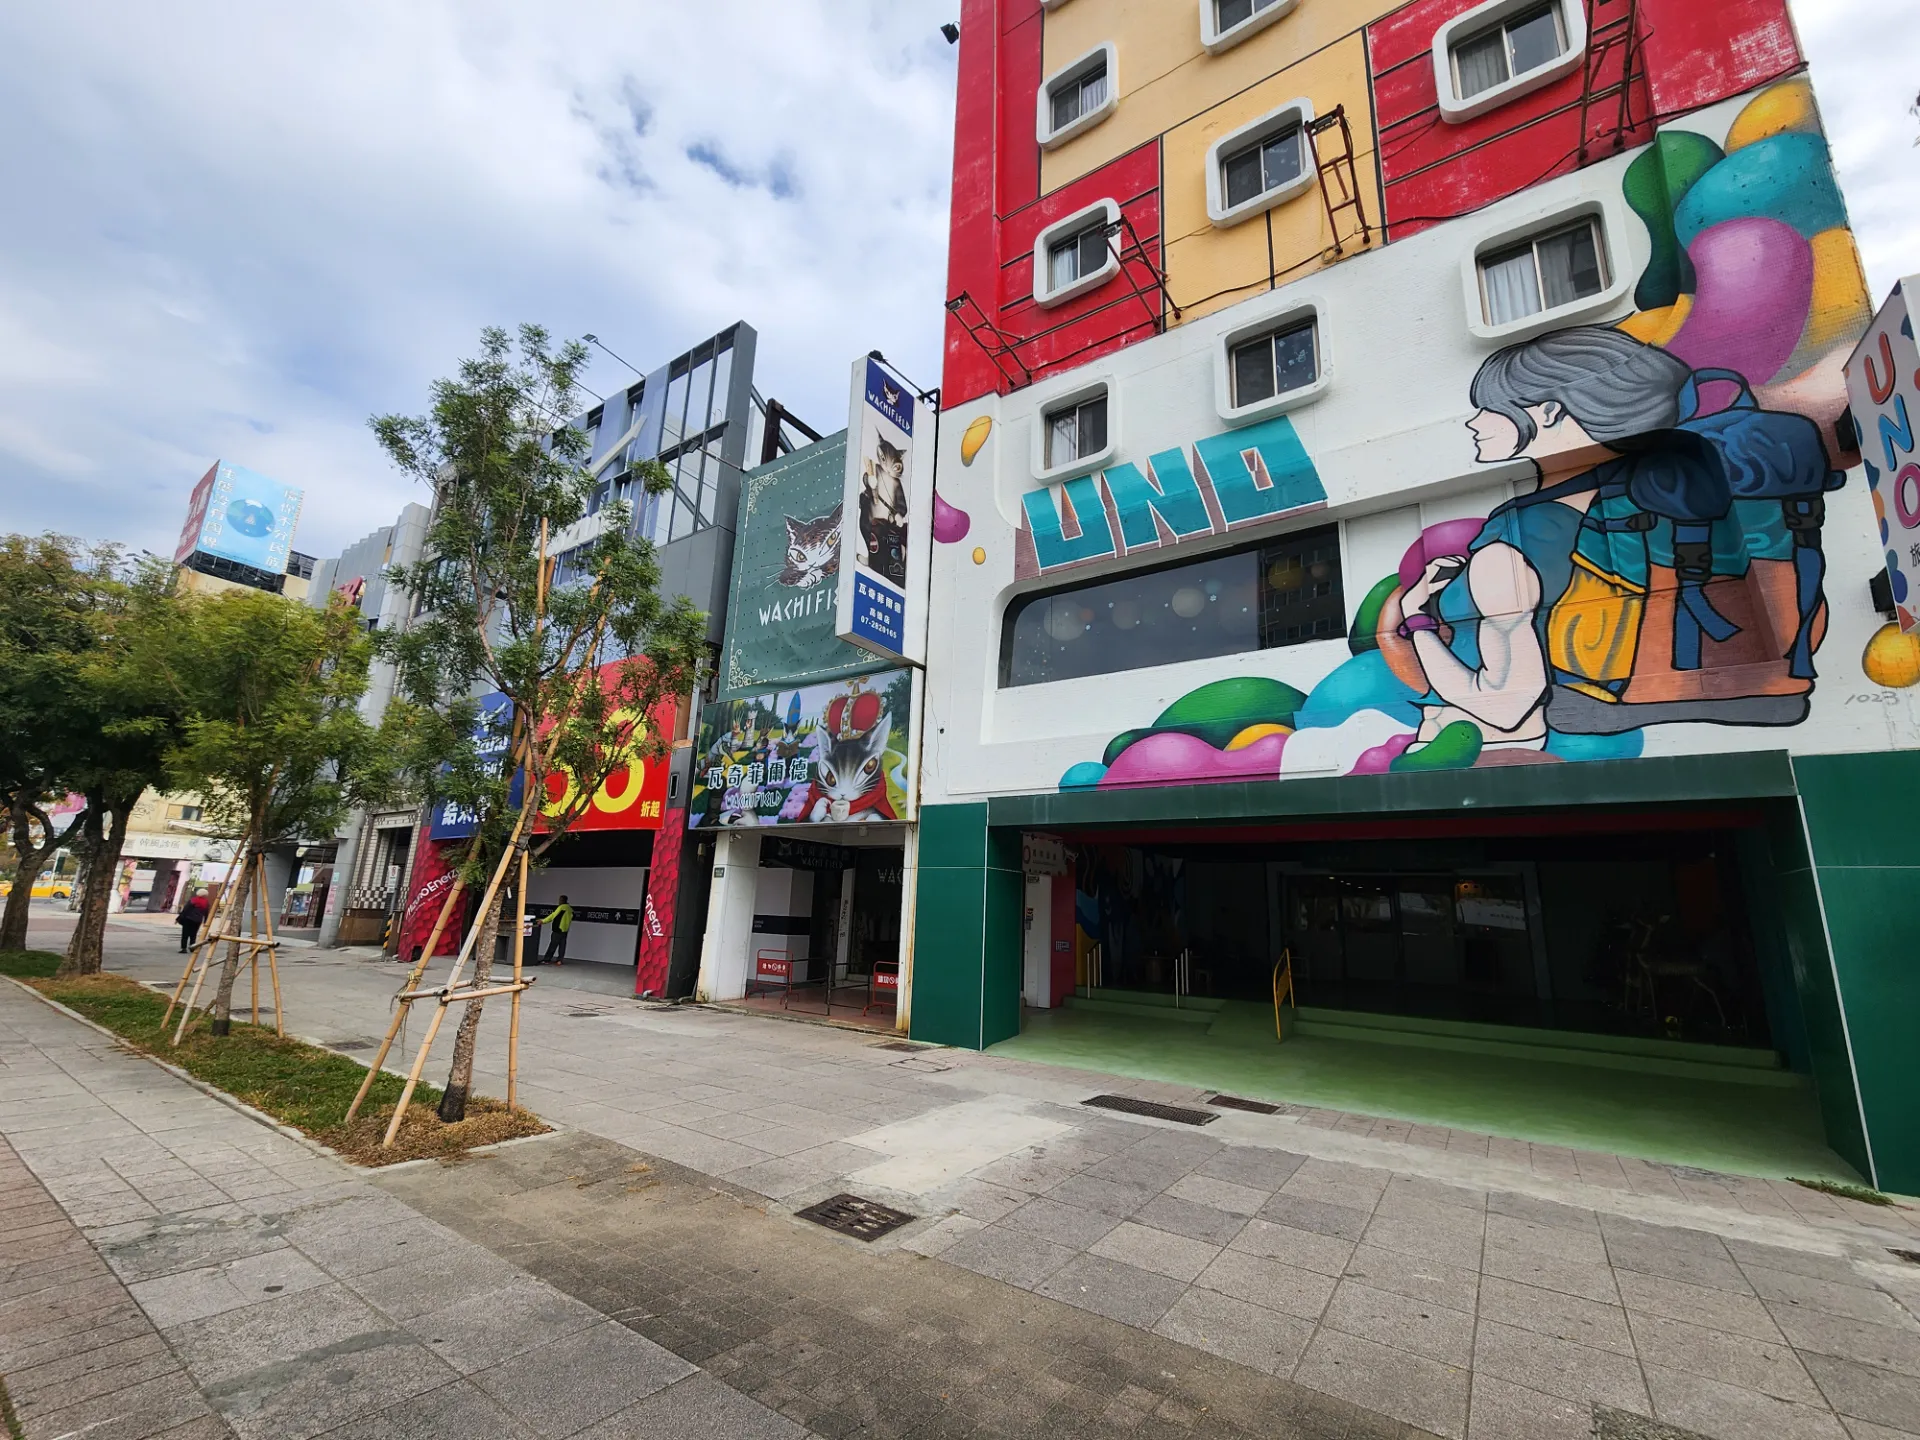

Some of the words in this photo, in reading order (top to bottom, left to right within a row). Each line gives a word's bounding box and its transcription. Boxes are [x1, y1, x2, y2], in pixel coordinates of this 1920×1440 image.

[868, 390, 911, 431] WACHIFIELD
[1018, 414, 1329, 577] UNO
[858, 582, 902, 614] 瓦奇菲爾德
[707, 757, 808, 790] 瓦奇菲爾德
[641, 800, 660, 818] 折起
[725, 789, 783, 810] WACHIFIELD
